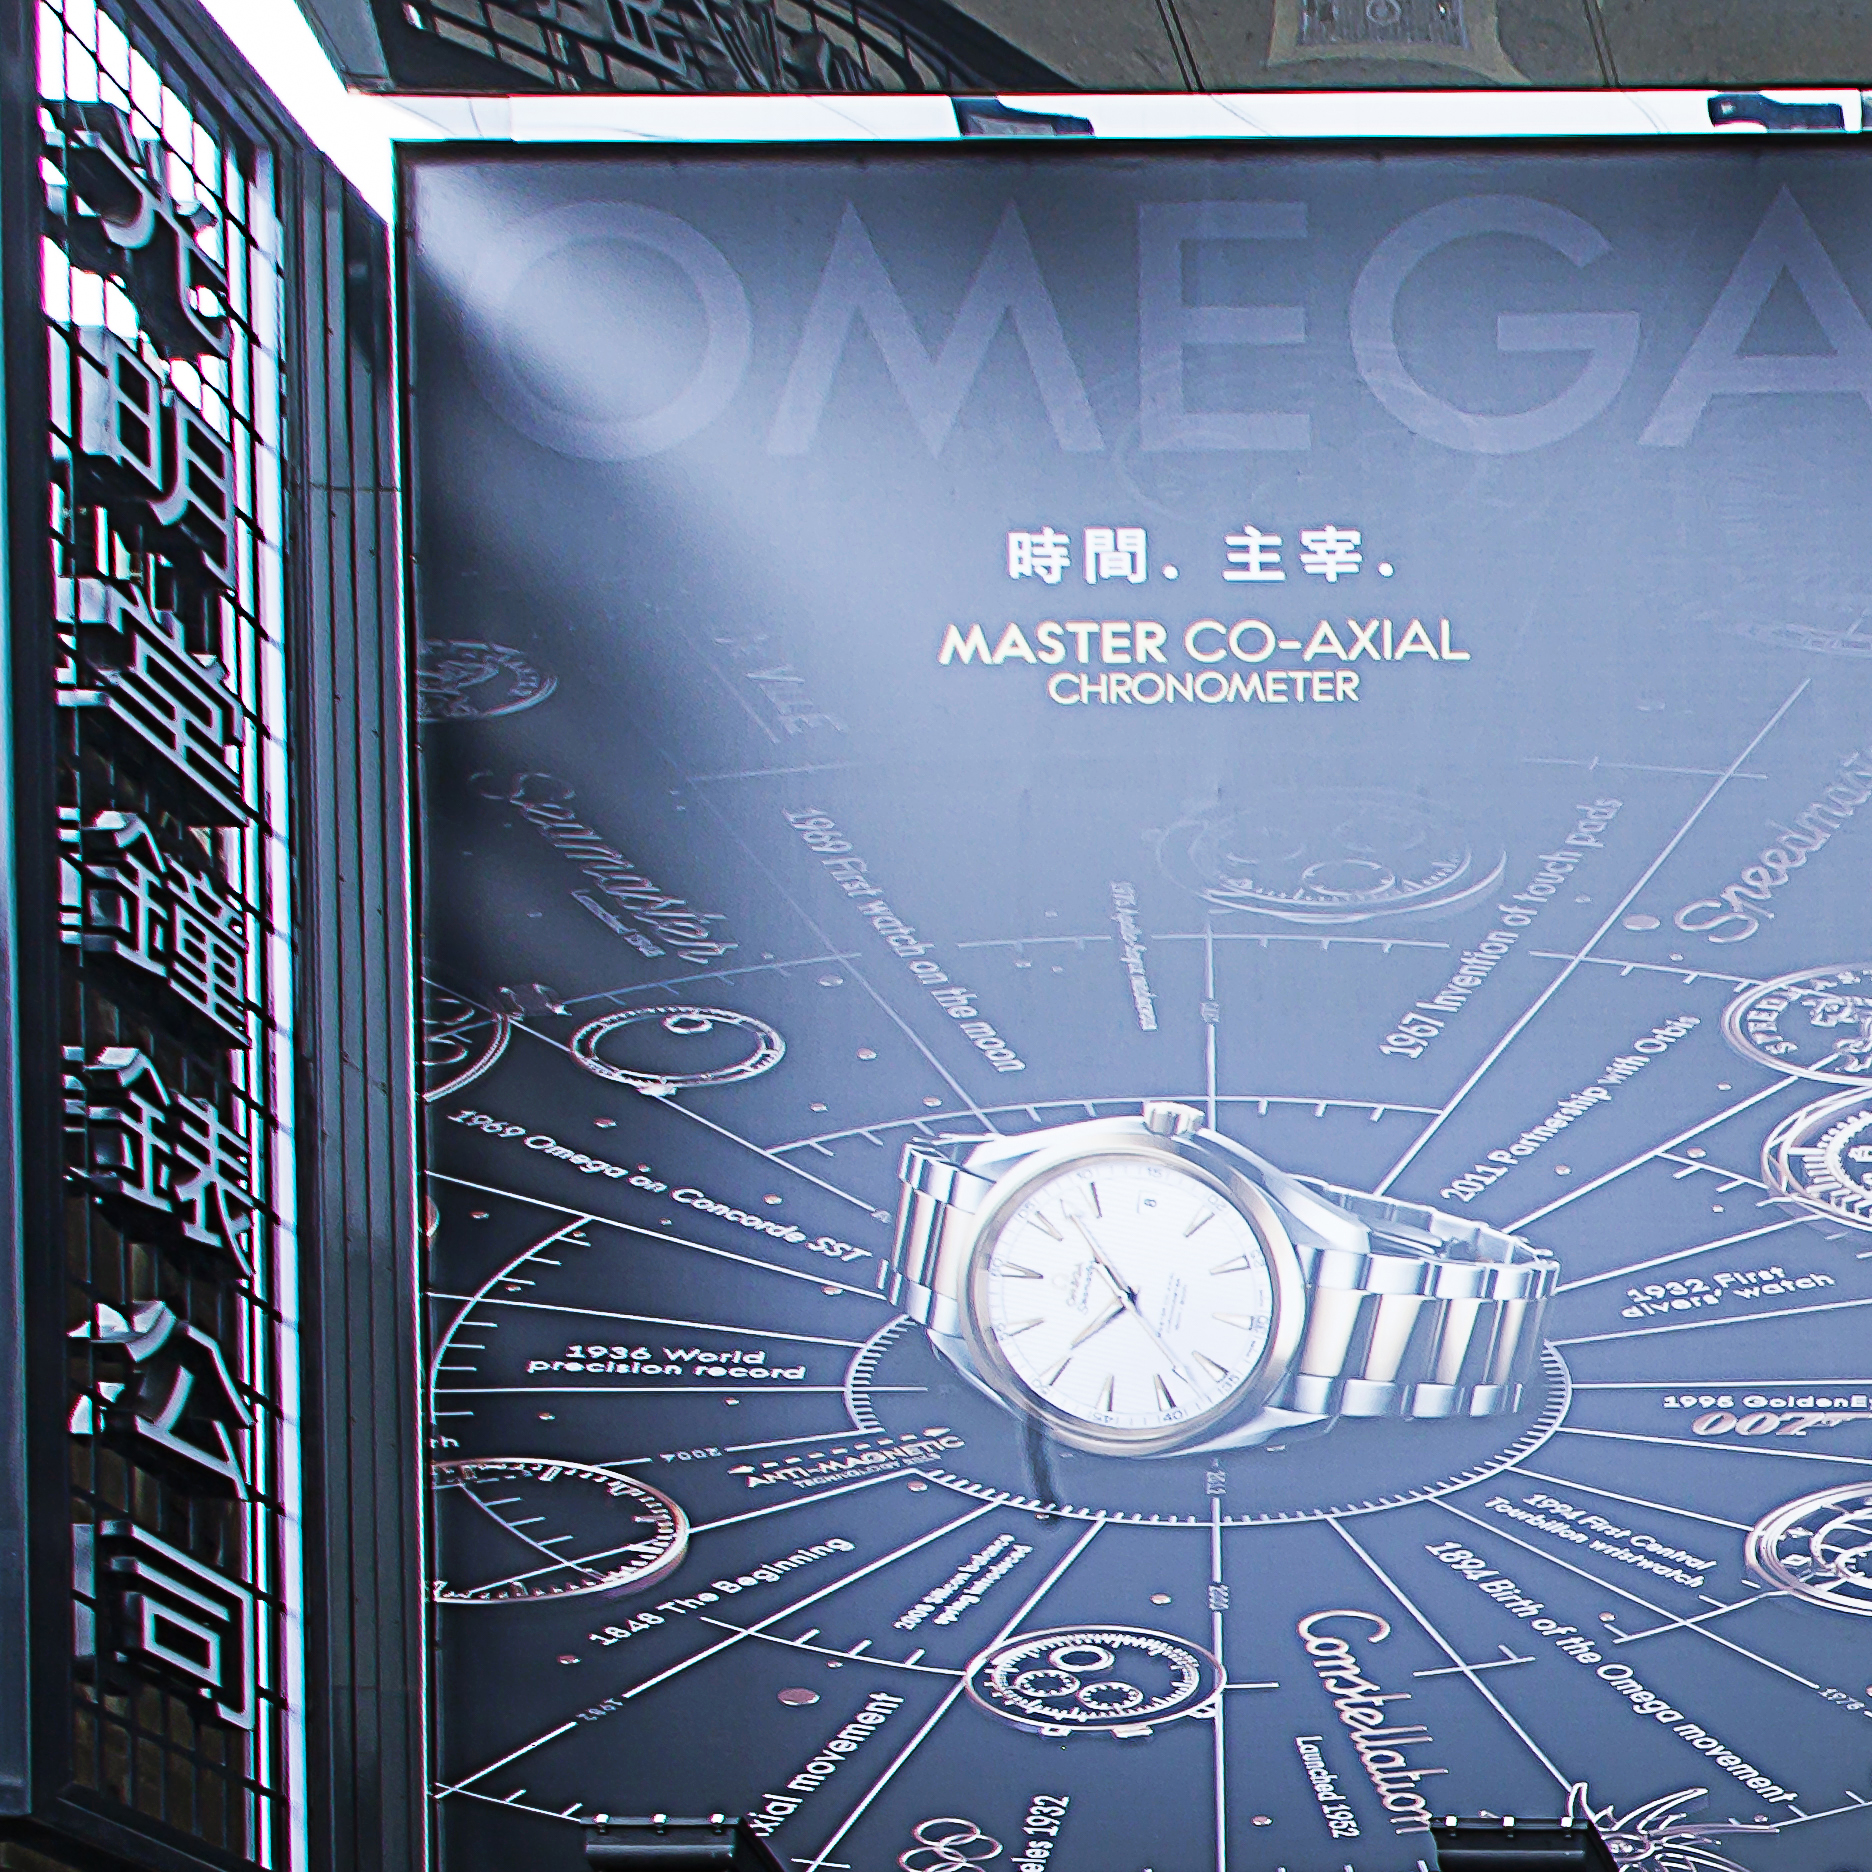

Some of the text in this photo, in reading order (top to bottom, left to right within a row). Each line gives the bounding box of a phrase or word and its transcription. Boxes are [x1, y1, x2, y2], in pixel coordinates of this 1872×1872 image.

[938, 619, 1470, 666] MASTER CO-AXIAL
[1047, 670, 1361, 706] CHRONOMETER
[1380, 1007, 1446, 1060] 1967
[1416, 928, 1518, 1015] Invention
[960, 1019, 1026, 1074] moon
[1441, 1014, 1702, 1202] 2011 Partnership with Orbis
[525, 1134, 628, 1182] Omega
[672, 1186, 807, 1246] Concorde
[806, 1236, 872, 1264] SST
[1733, 1271, 1837, 1300] watch
[526, 1359, 807, 1381] precision record
[662, 1347, 766, 1366] World
[1484, 1495, 1705, 1591] Tourbillon wristwatch
[1629, 1532, 1717, 1573] Central
[588, 1536, 856, 1648] 1848 The Beginning
[1478, 1573, 1538, 1622] Birth
[1532, 1615, 1577, 1642] of
[1556, 1634, 1602, 1668] the
[1596, 1662, 1685, 1725] Omega
[1673, 1720, 1799, 1807] movement
[787, 1691, 905, 1793] movement
[1026, 1794, 1070, 1838] 1932
